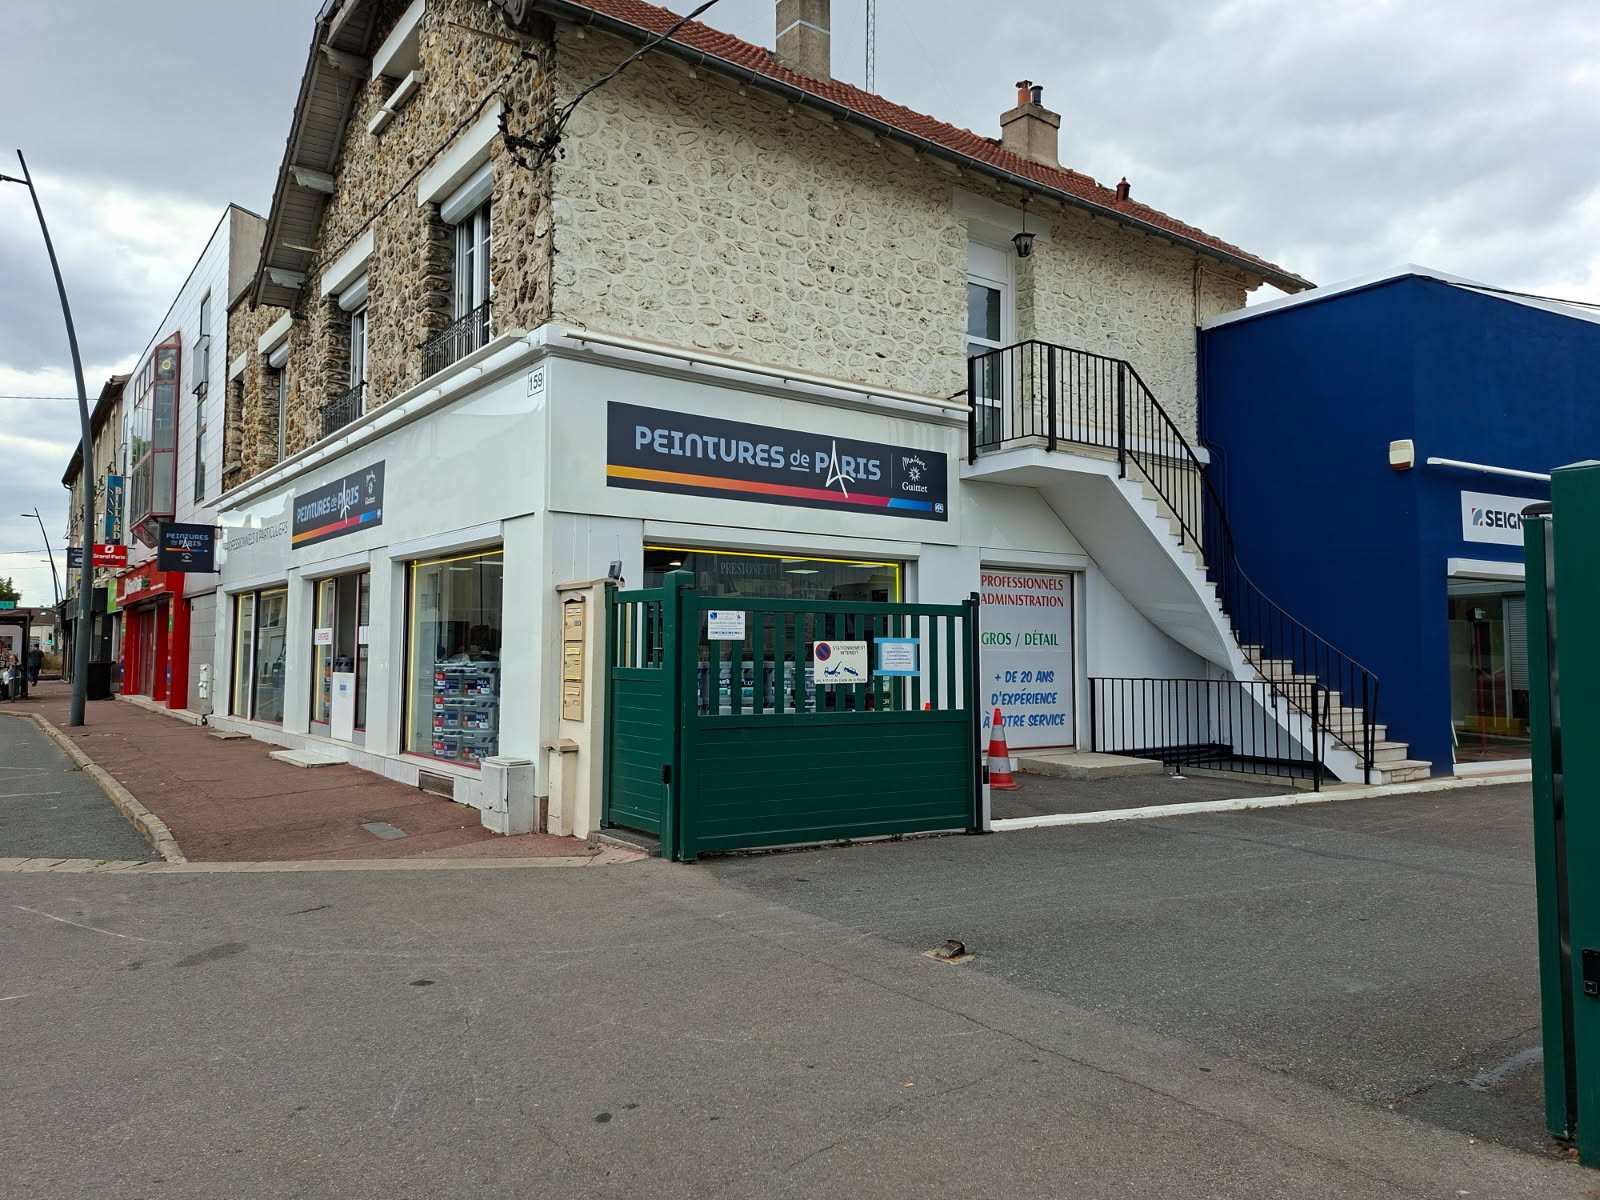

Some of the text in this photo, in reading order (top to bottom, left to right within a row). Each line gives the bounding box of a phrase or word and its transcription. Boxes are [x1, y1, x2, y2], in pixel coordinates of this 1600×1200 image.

[529, 372, 543, 391] 159
[635, 425, 881, 498] PEINTURES de PARIS
[901, 481, 928, 493] Guittet
[296, 497, 331, 524] PEINTURES
[331, 495, 337, 509] de
[337, 480, 360, 524] PARIS
[113, 487, 122, 539] BILLARD
[166, 532, 209, 540] PEINTURES
[179, 537, 201, 550] PARIS
[981, 575, 1064, 591] PROFESSIONNELS
[981, 593, 1064, 608] ADMINISTRATION
[981, 629, 1059, 647] GROS / DÉTAIL
[1005, 671, 1018, 683] DE
[1020, 671, 1033, 683] 20
[1036, 671, 1055, 683] ANS
[991, 688, 1058, 706] D'EXPÉRIENCE
[1001, 715, 1026, 728] OTRE
[1028, 714, 1066, 727] SERVICE
